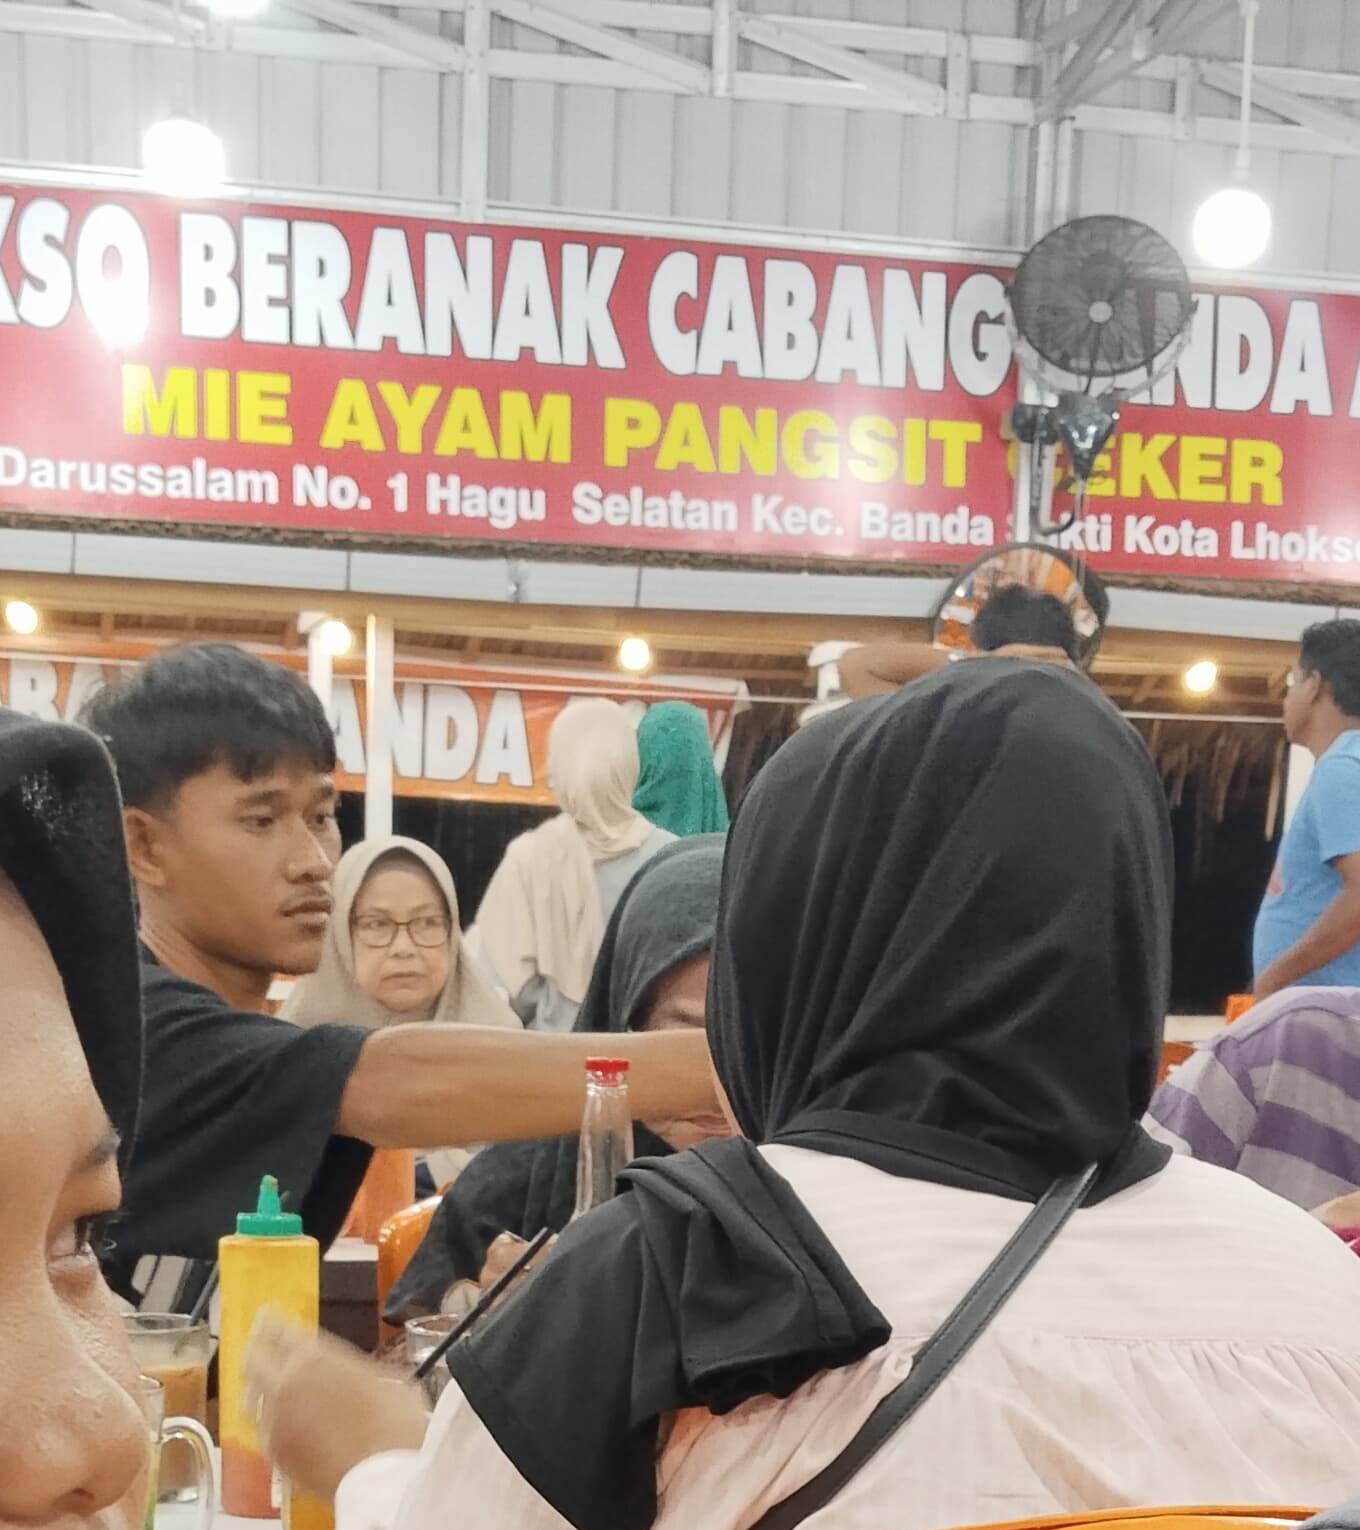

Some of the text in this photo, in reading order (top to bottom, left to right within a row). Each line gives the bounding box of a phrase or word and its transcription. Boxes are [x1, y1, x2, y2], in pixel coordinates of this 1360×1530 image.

[181, 215, 626, 369] BERANAK
[649, 251, 1013, 396] CABANG
[122, 367, 293, 444] MIE
[321, 380, 572, 463] AYAM
[603, 397, 981, 488] PANGSIT
[291, 466, 372, 512] No.
[386, 474, 410, 513] 1
[427, 478, 547, 527] Hagu
[572, 481, 738, 532] Selatan
[752, 499, 845, 538] Kec.
[859, 503, 994, 546] Banda
[1006, 512, 1113, 554] kti
[1123, 513, 1219, 560] Kota
[331, 680, 533, 787] ANDA
